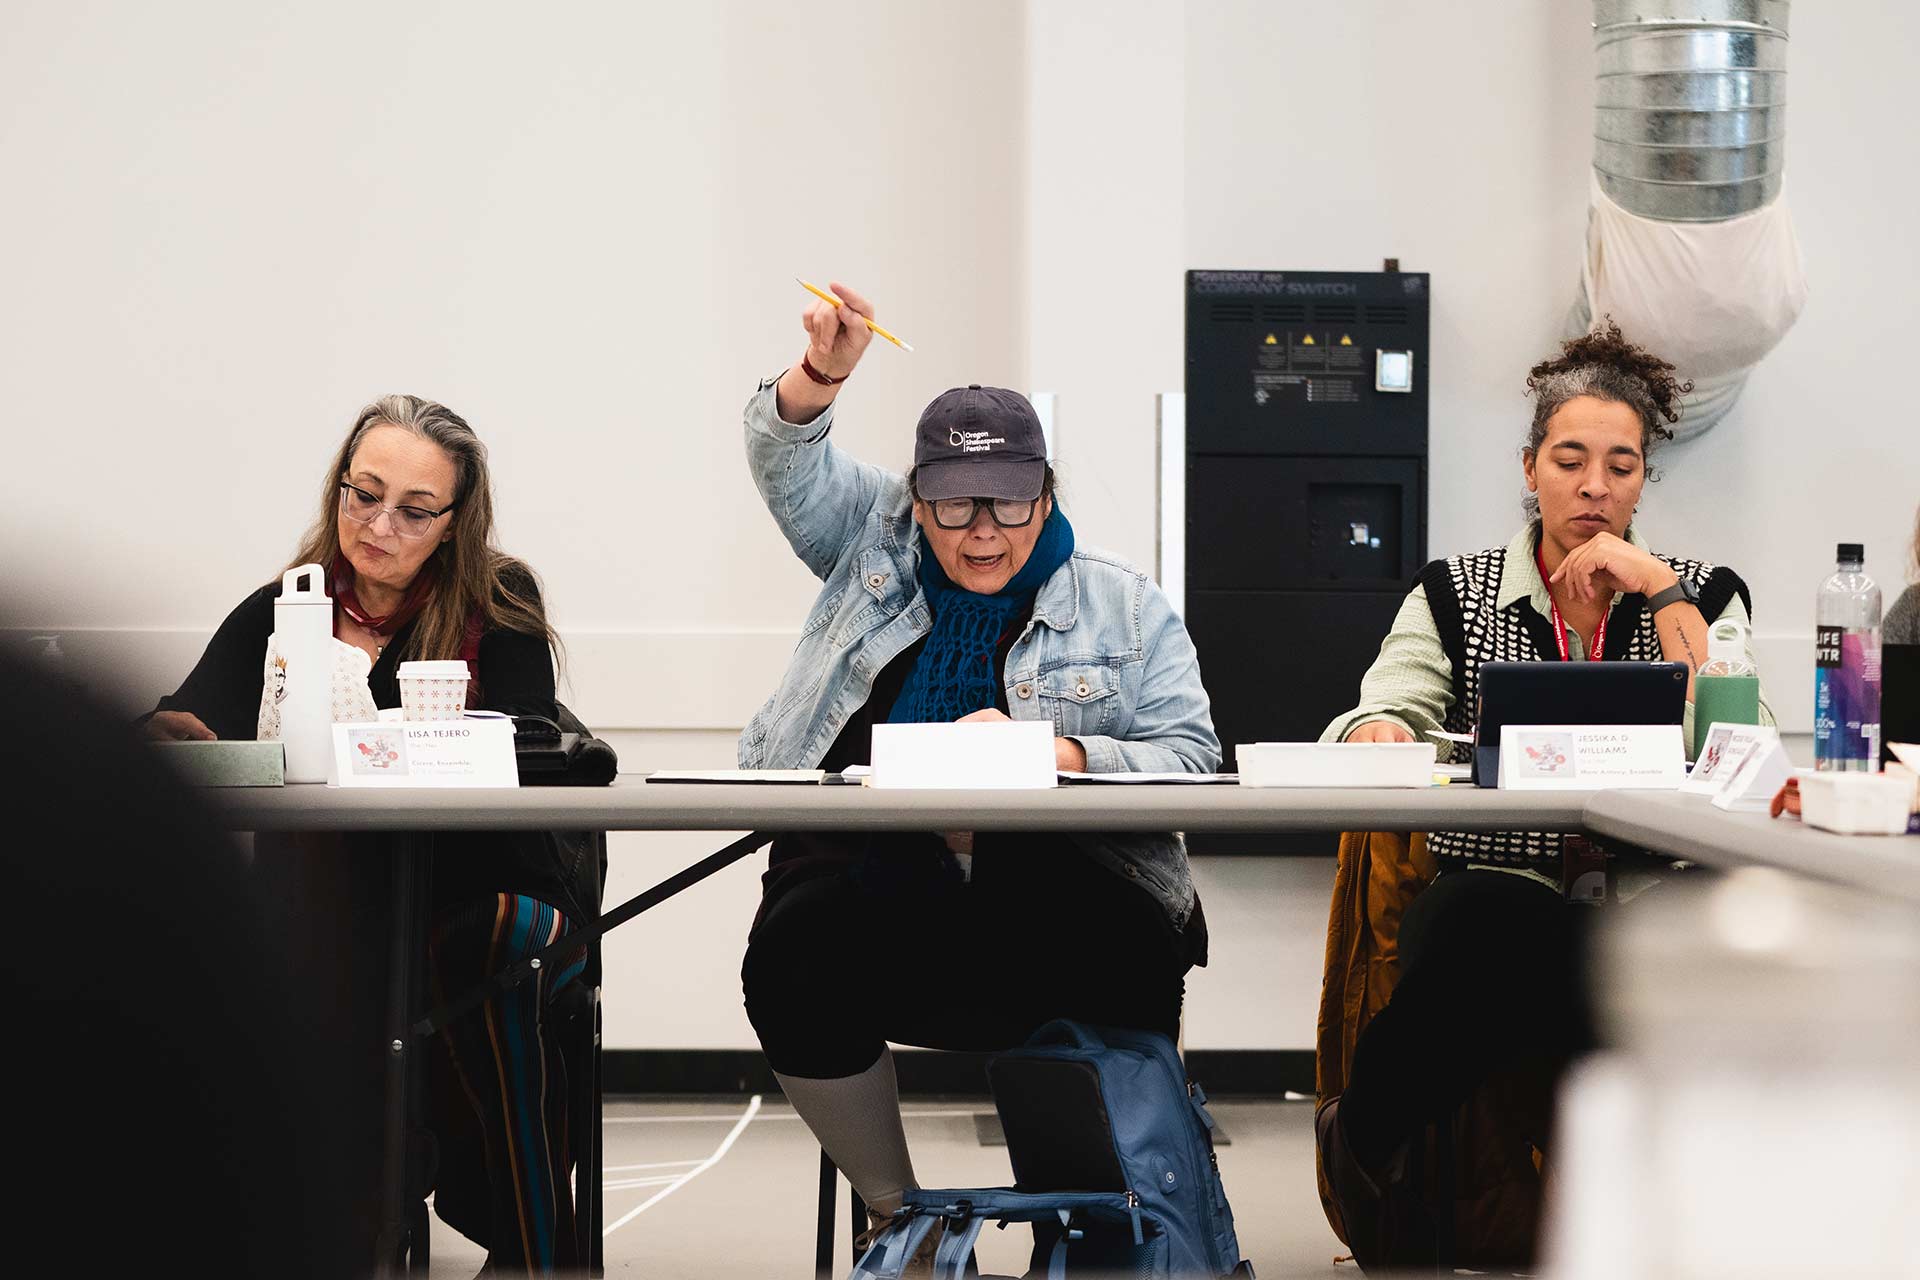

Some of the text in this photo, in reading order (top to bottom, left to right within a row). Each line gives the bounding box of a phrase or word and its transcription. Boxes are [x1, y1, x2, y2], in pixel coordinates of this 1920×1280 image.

[1195, 282, 1357, 295] COMPANY SWITCH
[966, 432, 989, 440] Oregon
[966, 444, 990, 452] Festival
[409, 729, 470, 738] LISA TEJERO
